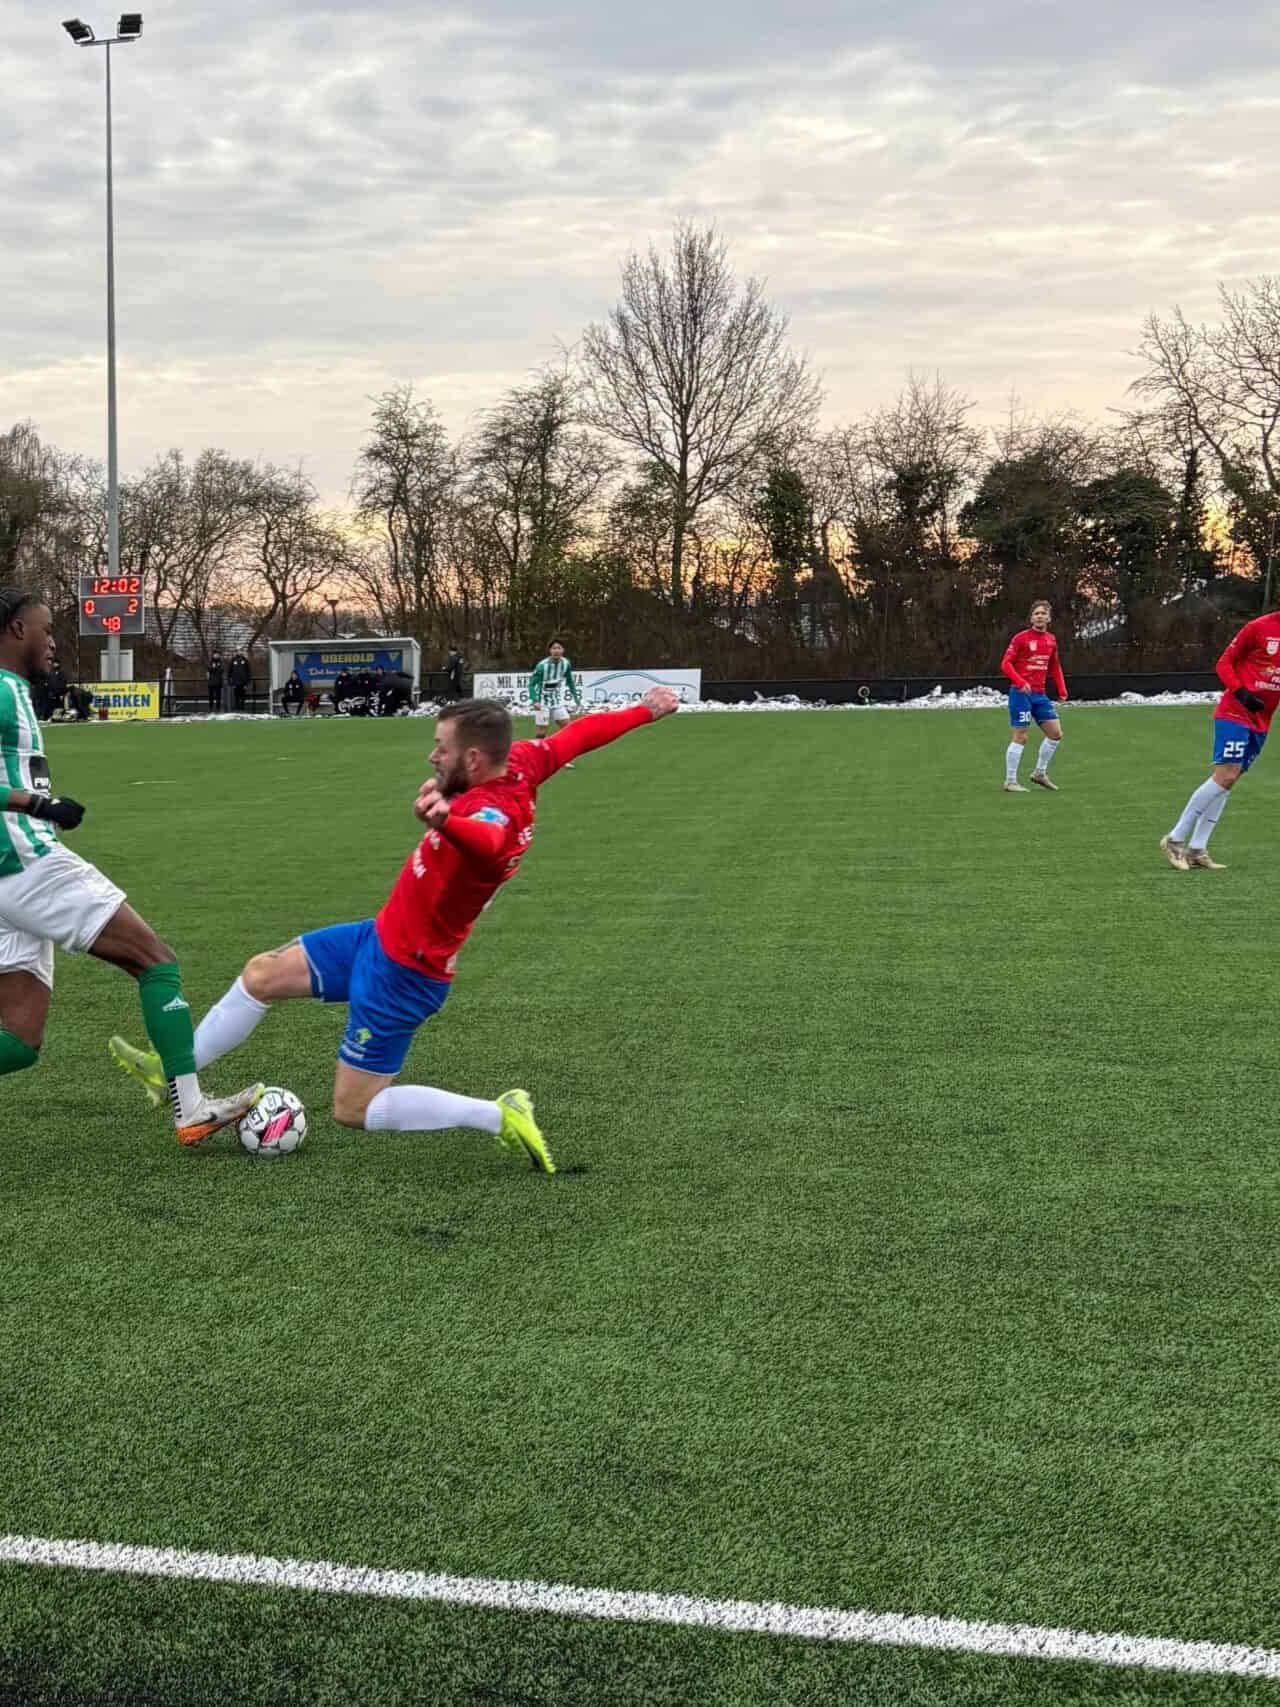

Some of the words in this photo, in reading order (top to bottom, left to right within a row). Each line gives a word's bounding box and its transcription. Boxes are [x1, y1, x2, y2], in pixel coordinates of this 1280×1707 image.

[94, 578, 140, 594] 12:02
[84, 600, 95, 614] 0
[128, 599, 138, 613] 2
[102, 616, 121, 631] 48
[1223, 741, 1246, 758] 25
